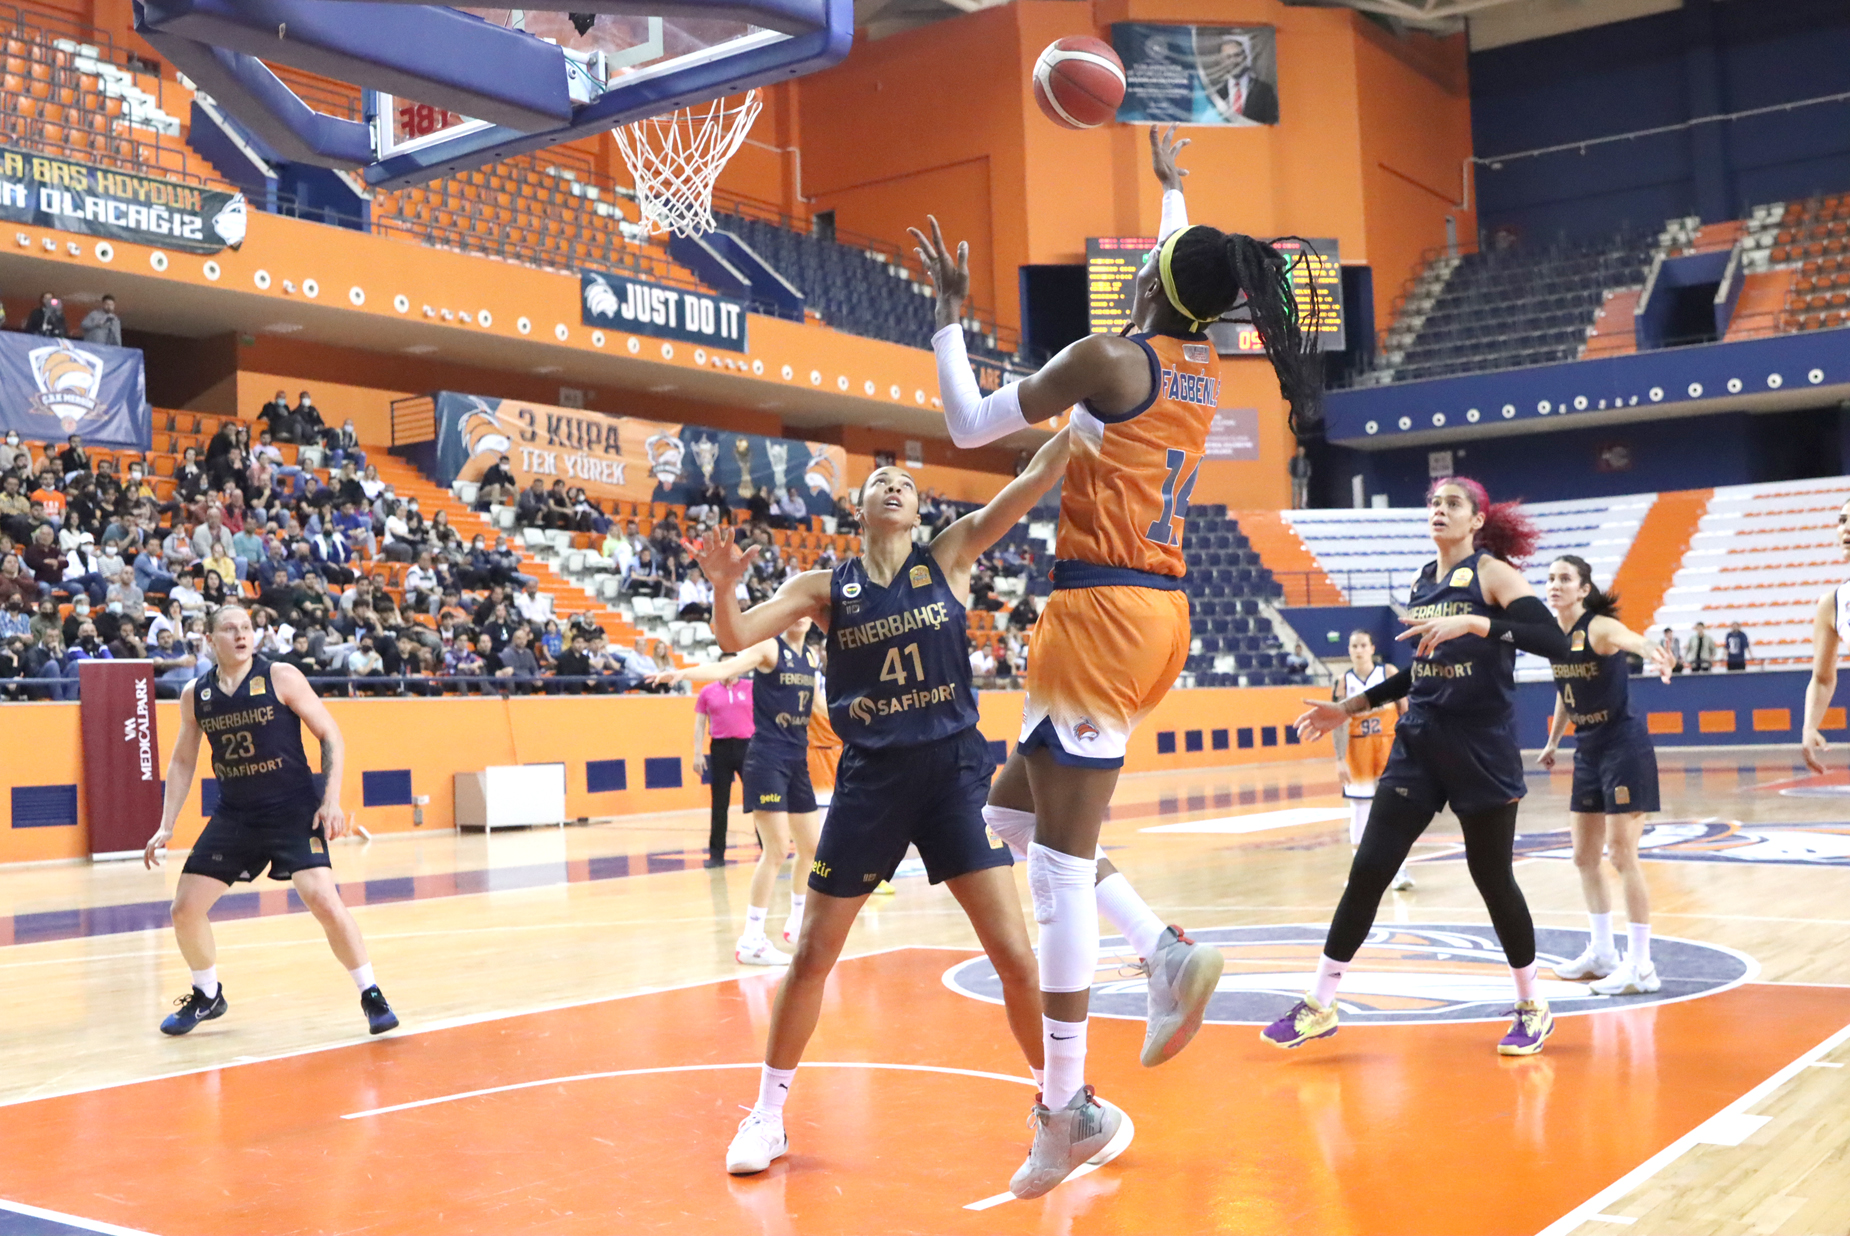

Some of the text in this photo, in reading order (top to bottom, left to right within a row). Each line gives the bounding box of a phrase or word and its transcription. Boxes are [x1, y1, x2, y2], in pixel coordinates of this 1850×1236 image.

[0, 151, 23, 178] A
[621, 282, 741, 340] JUST DO IT
[519, 408, 622, 457] 3 KUPA
[519, 447, 626, 485] TEK YÜREK
[837, 602, 949, 650] FENERBAHÇE
[879, 642, 925, 686] 41
[877, 683, 956, 716] SAFİPORT
[1564, 683, 1576, 708] 4
[135, 678, 153, 780] MEDICALPARK
[201, 706, 275, 733] FENERBAHÇE
[1361, 718, 1382, 735] 92
[222, 731, 256, 760] 23
[225, 758, 283, 778] SAFİPORT
[760, 793, 781, 804] getir
[812, 860, 831, 878] etir
